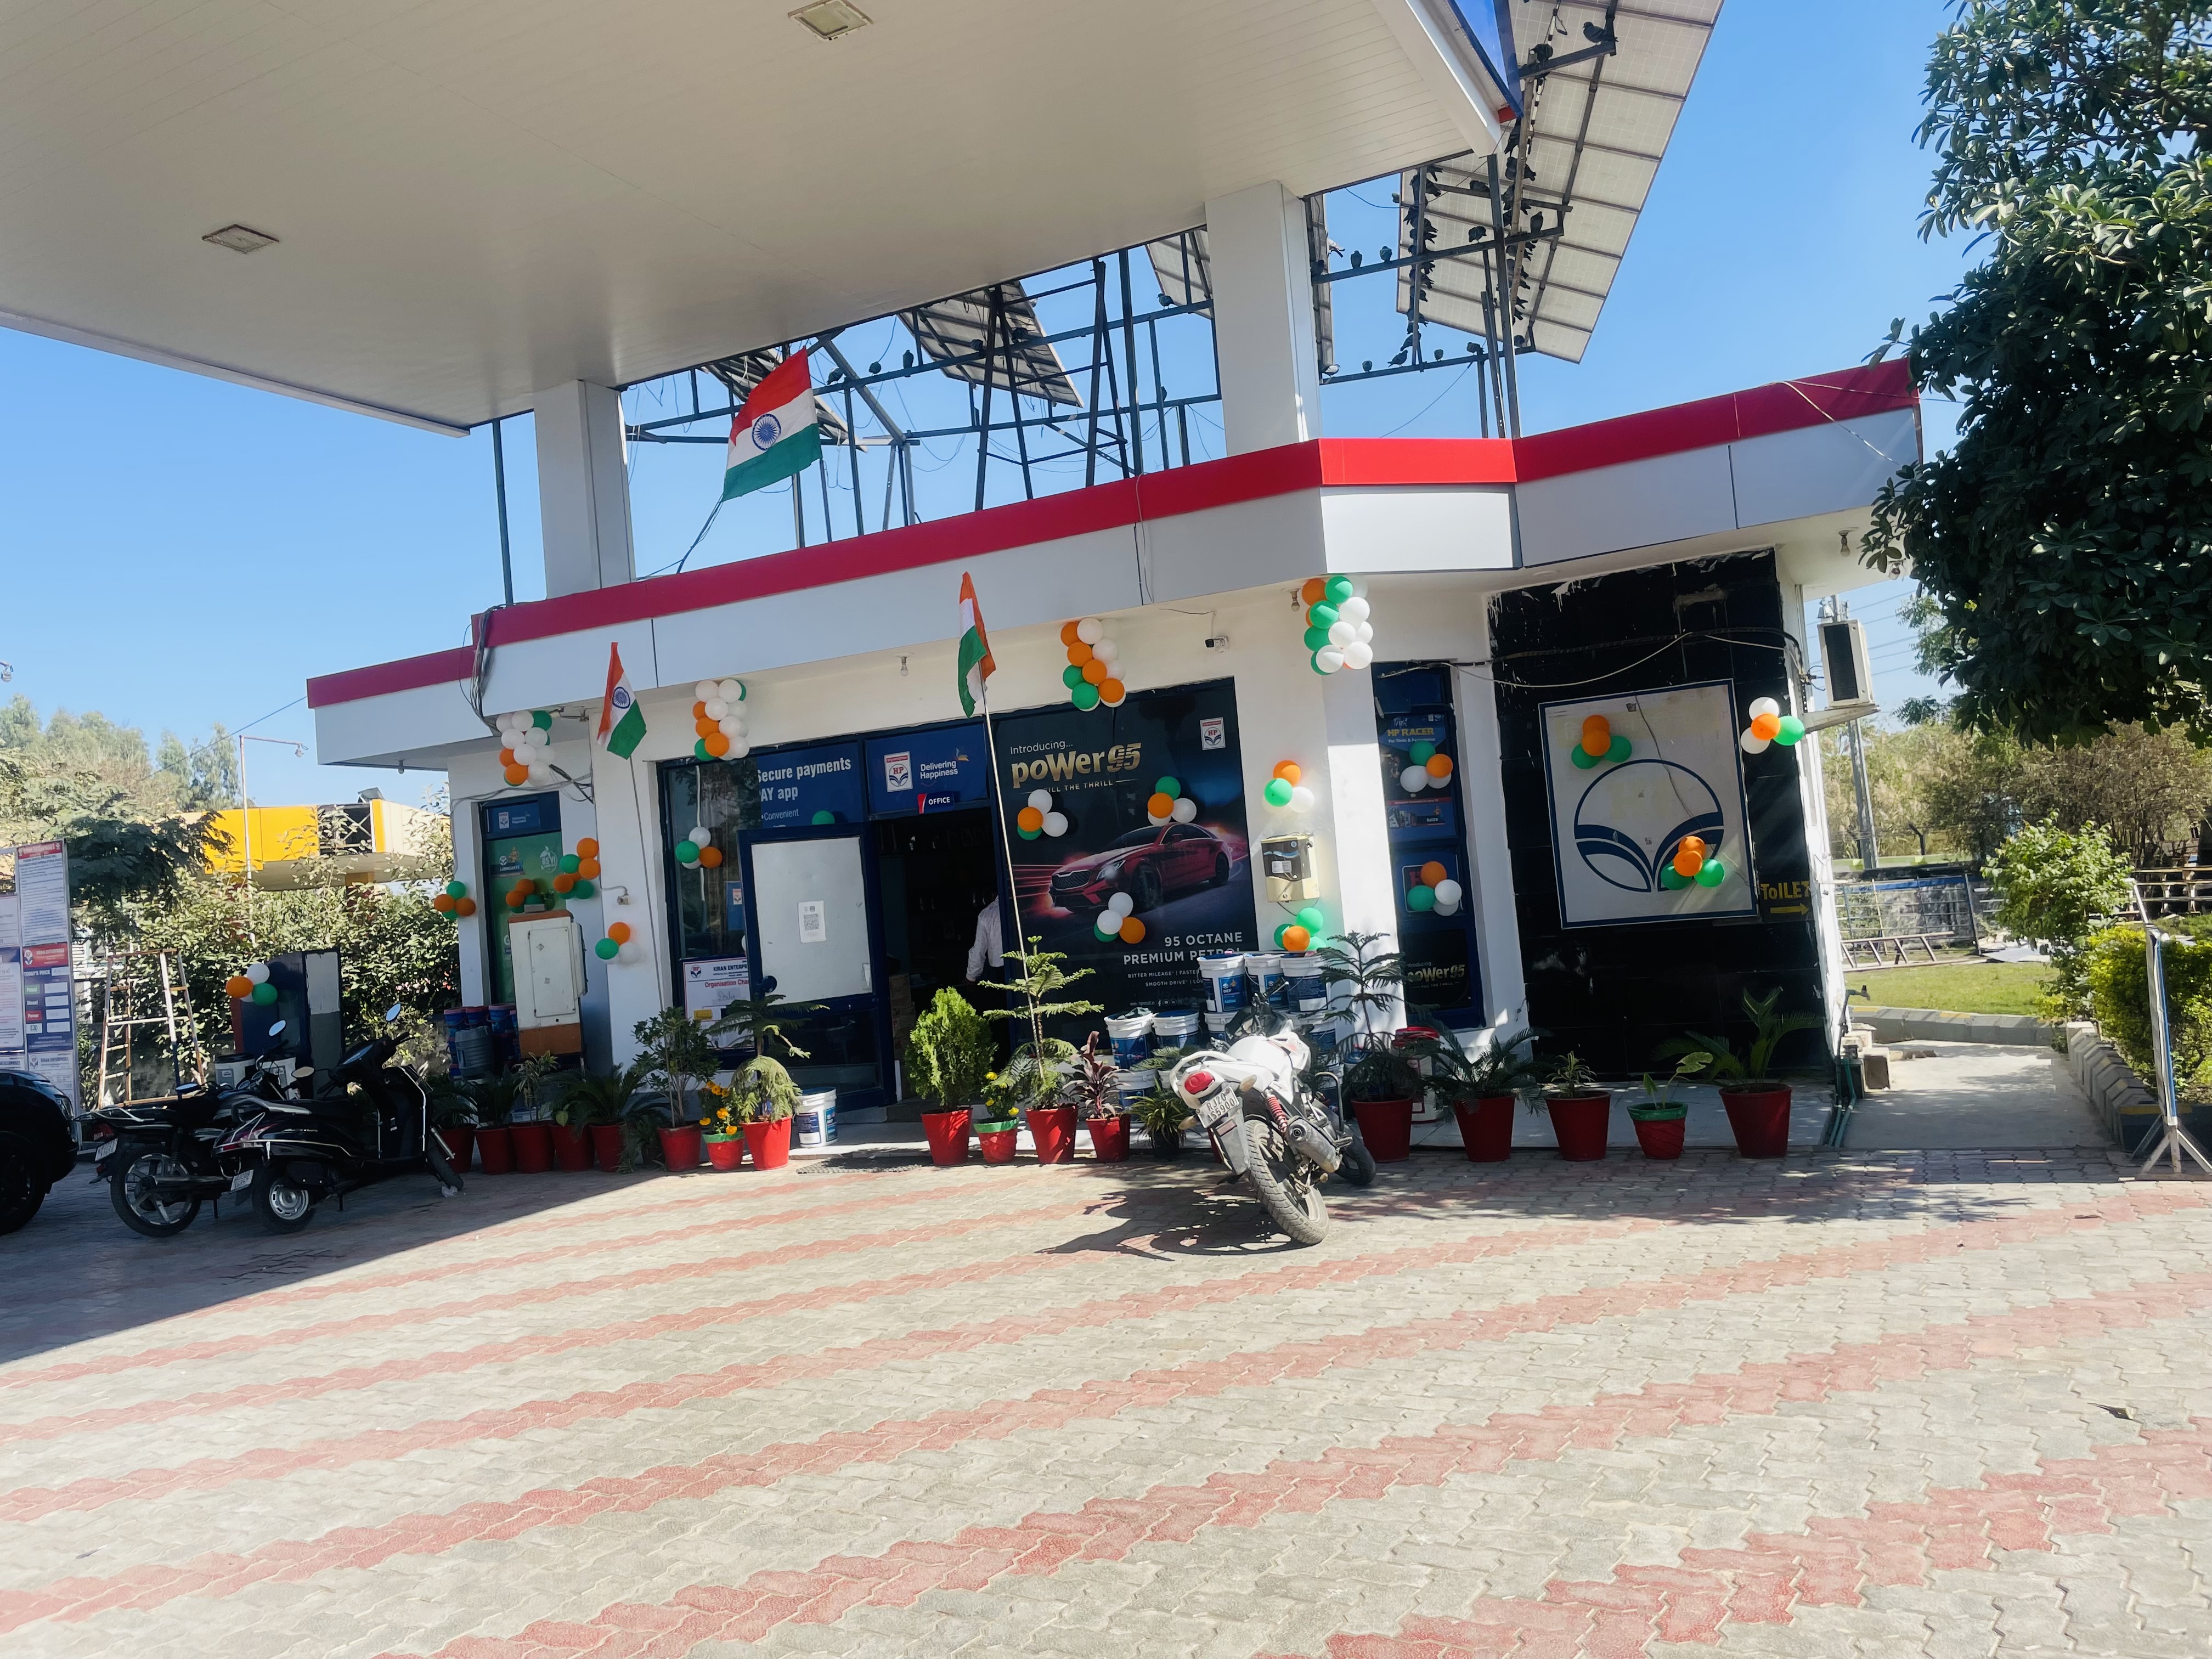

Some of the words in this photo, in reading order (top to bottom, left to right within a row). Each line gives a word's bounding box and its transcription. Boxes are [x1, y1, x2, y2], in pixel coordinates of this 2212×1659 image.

[1402, 727, 1434, 736] RACER
[757, 768, 793, 783] Secure
[797, 757, 851, 780] payments
[893, 766, 904, 775] HP
[920, 760, 956, 771] Delivering
[920, 769, 958, 780] Happiness
[1084, 780, 1113, 789] THRILL
[759, 787, 774, 802] AY
[777, 786, 798, 802] app
[928, 797, 951, 805] OFFICE
[1164, 936, 1181, 947] 95
[1186, 932, 1243, 945] OCTANE
[1124, 951, 1184, 965] PREMIUM
[704, 980, 736, 988] Organisation
[1206, 1093, 1227, 1111] RJ20
[1207, 1098, 1235, 1124] AS5900
